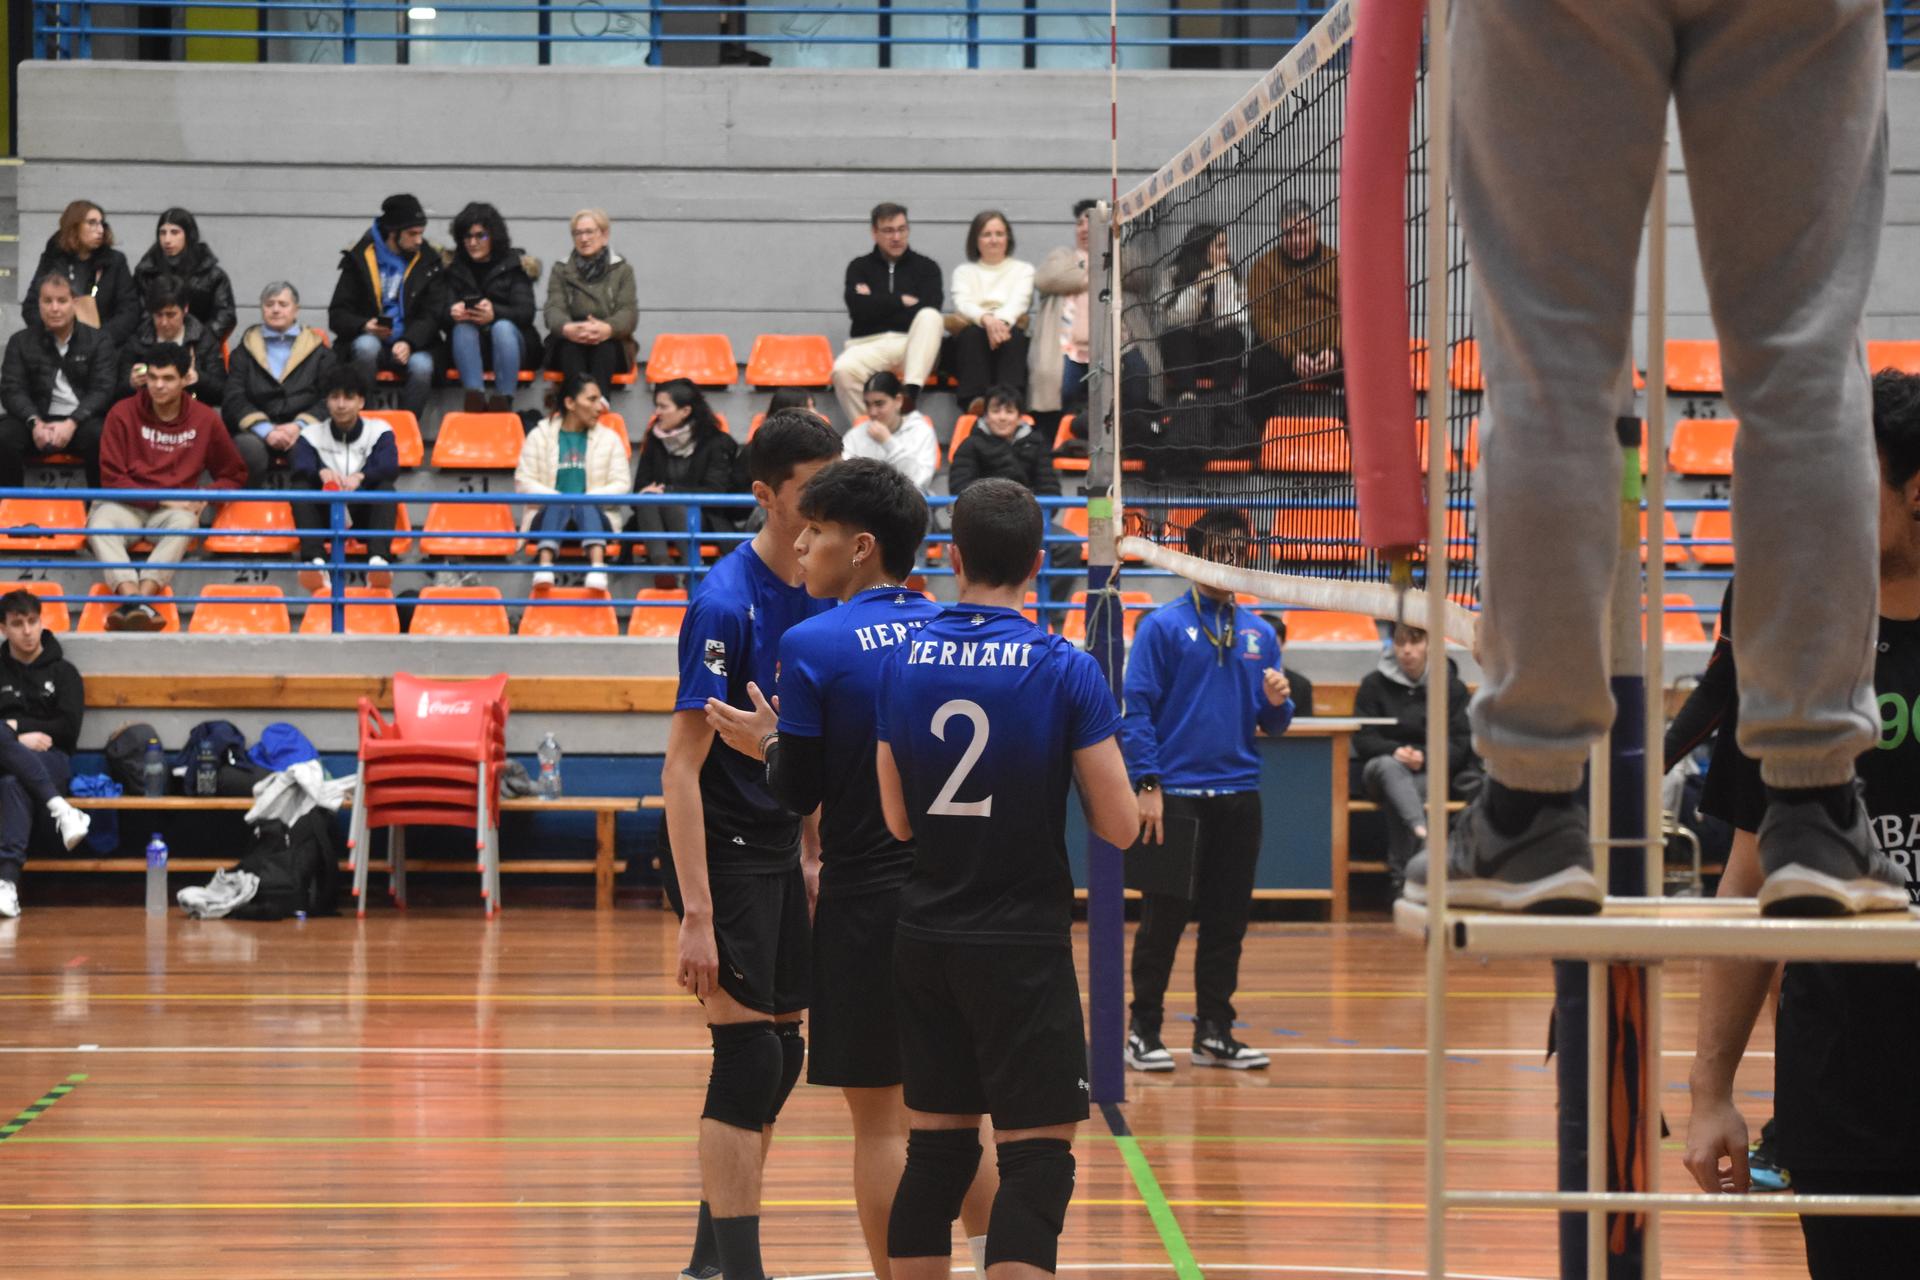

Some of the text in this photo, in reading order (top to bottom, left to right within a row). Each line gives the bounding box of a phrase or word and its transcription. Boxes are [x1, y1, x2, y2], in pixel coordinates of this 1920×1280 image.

[907, 640, 1033, 667] HERNANI
[1876, 691, 1920, 751] 9
[926, 699, 993, 818] 2
